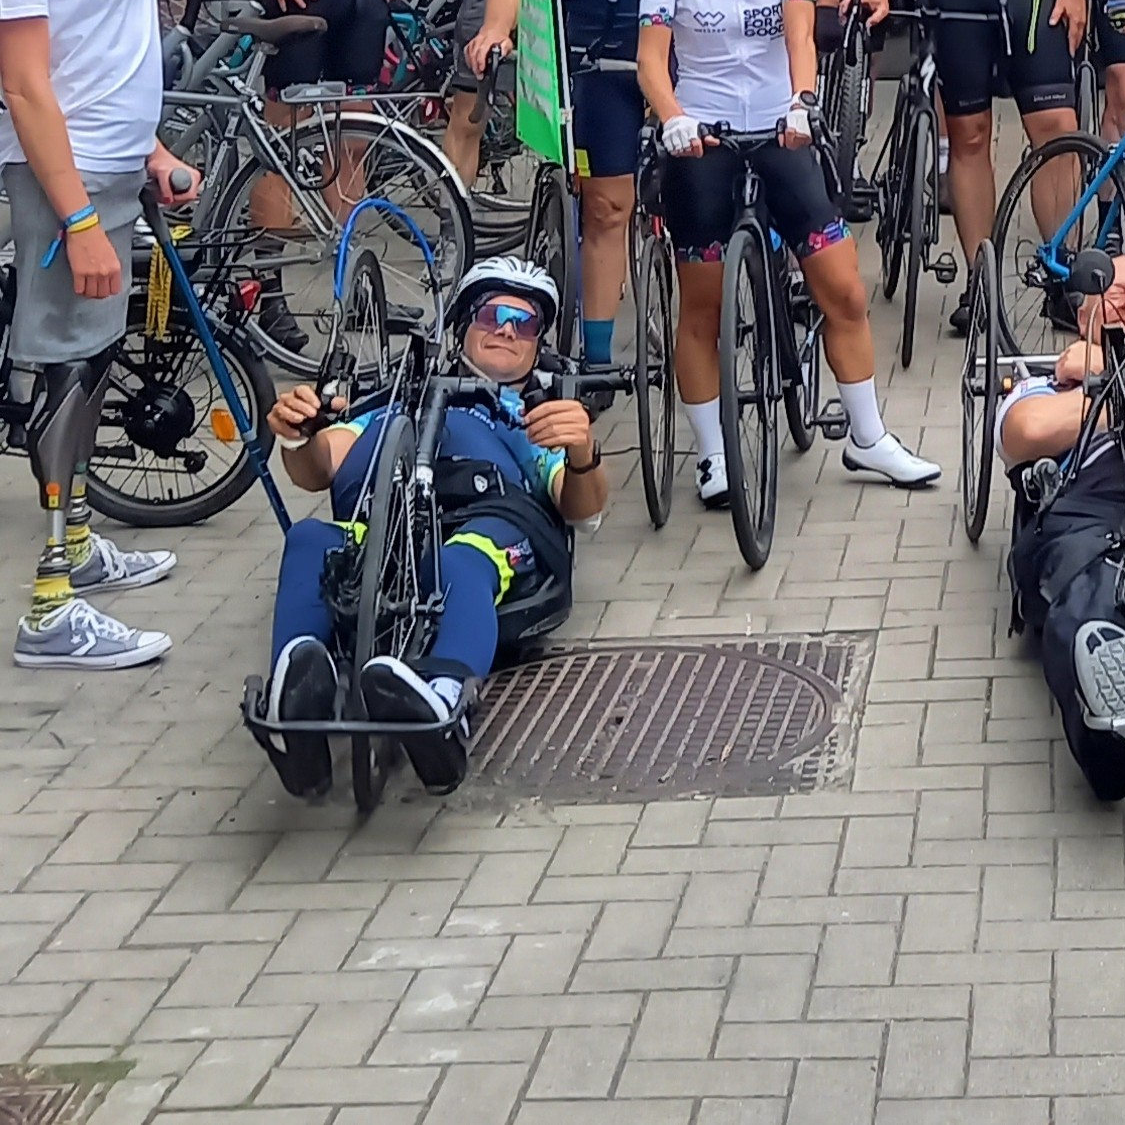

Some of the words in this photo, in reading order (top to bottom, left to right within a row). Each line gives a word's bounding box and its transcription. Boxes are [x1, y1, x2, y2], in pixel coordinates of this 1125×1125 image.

[743, 2, 784, 20] SPORT
[744, 18, 773, 30] FOR
[744, 24, 785, 37] GOOD
